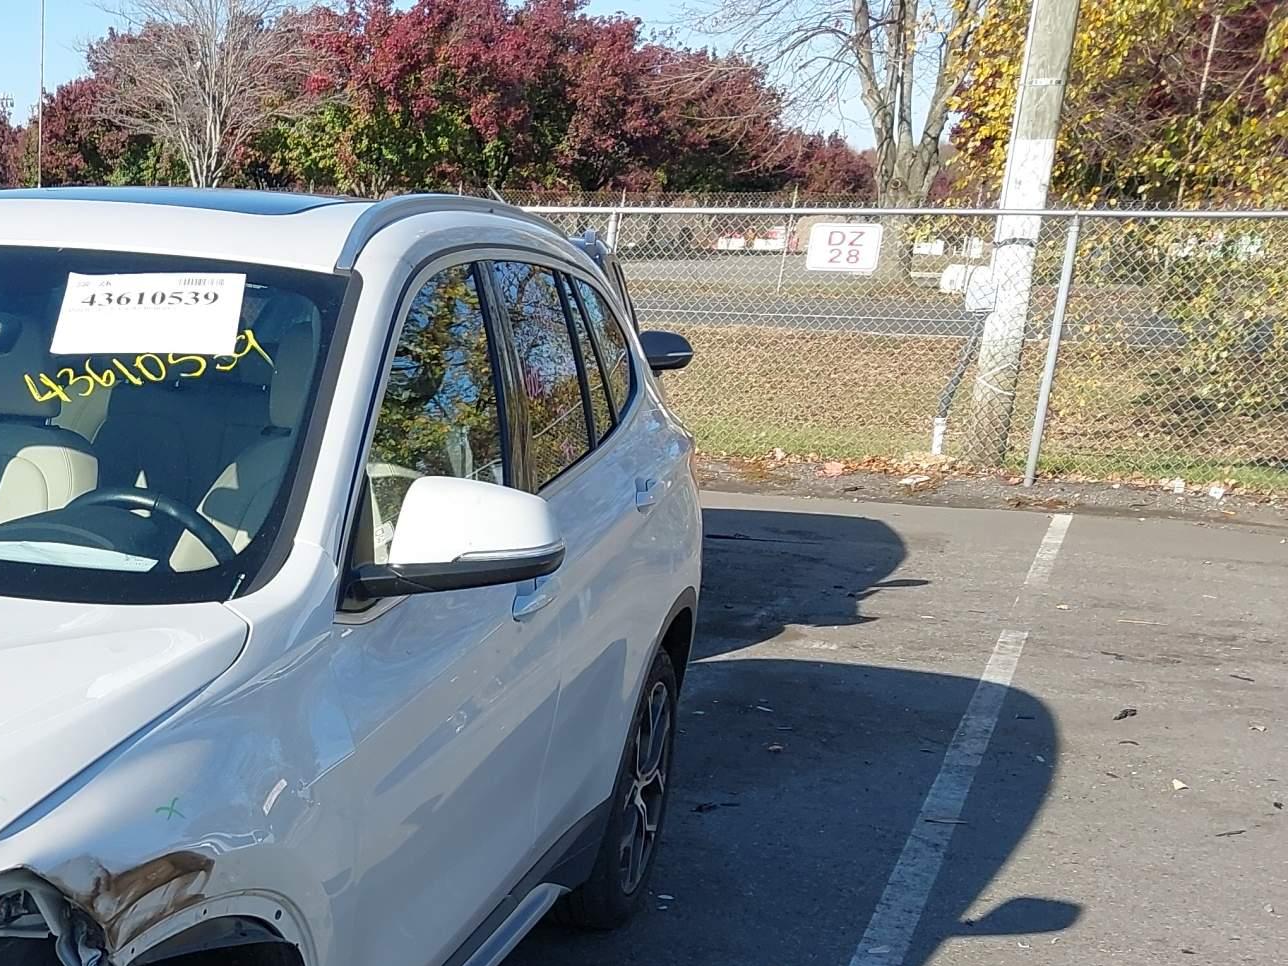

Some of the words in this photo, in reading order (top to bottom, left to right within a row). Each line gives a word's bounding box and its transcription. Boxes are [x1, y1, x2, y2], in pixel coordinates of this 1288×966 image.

[827, 230, 866, 247] DZ
[827, 248, 861, 264] 28
[81, 290, 219, 307] 43610539
